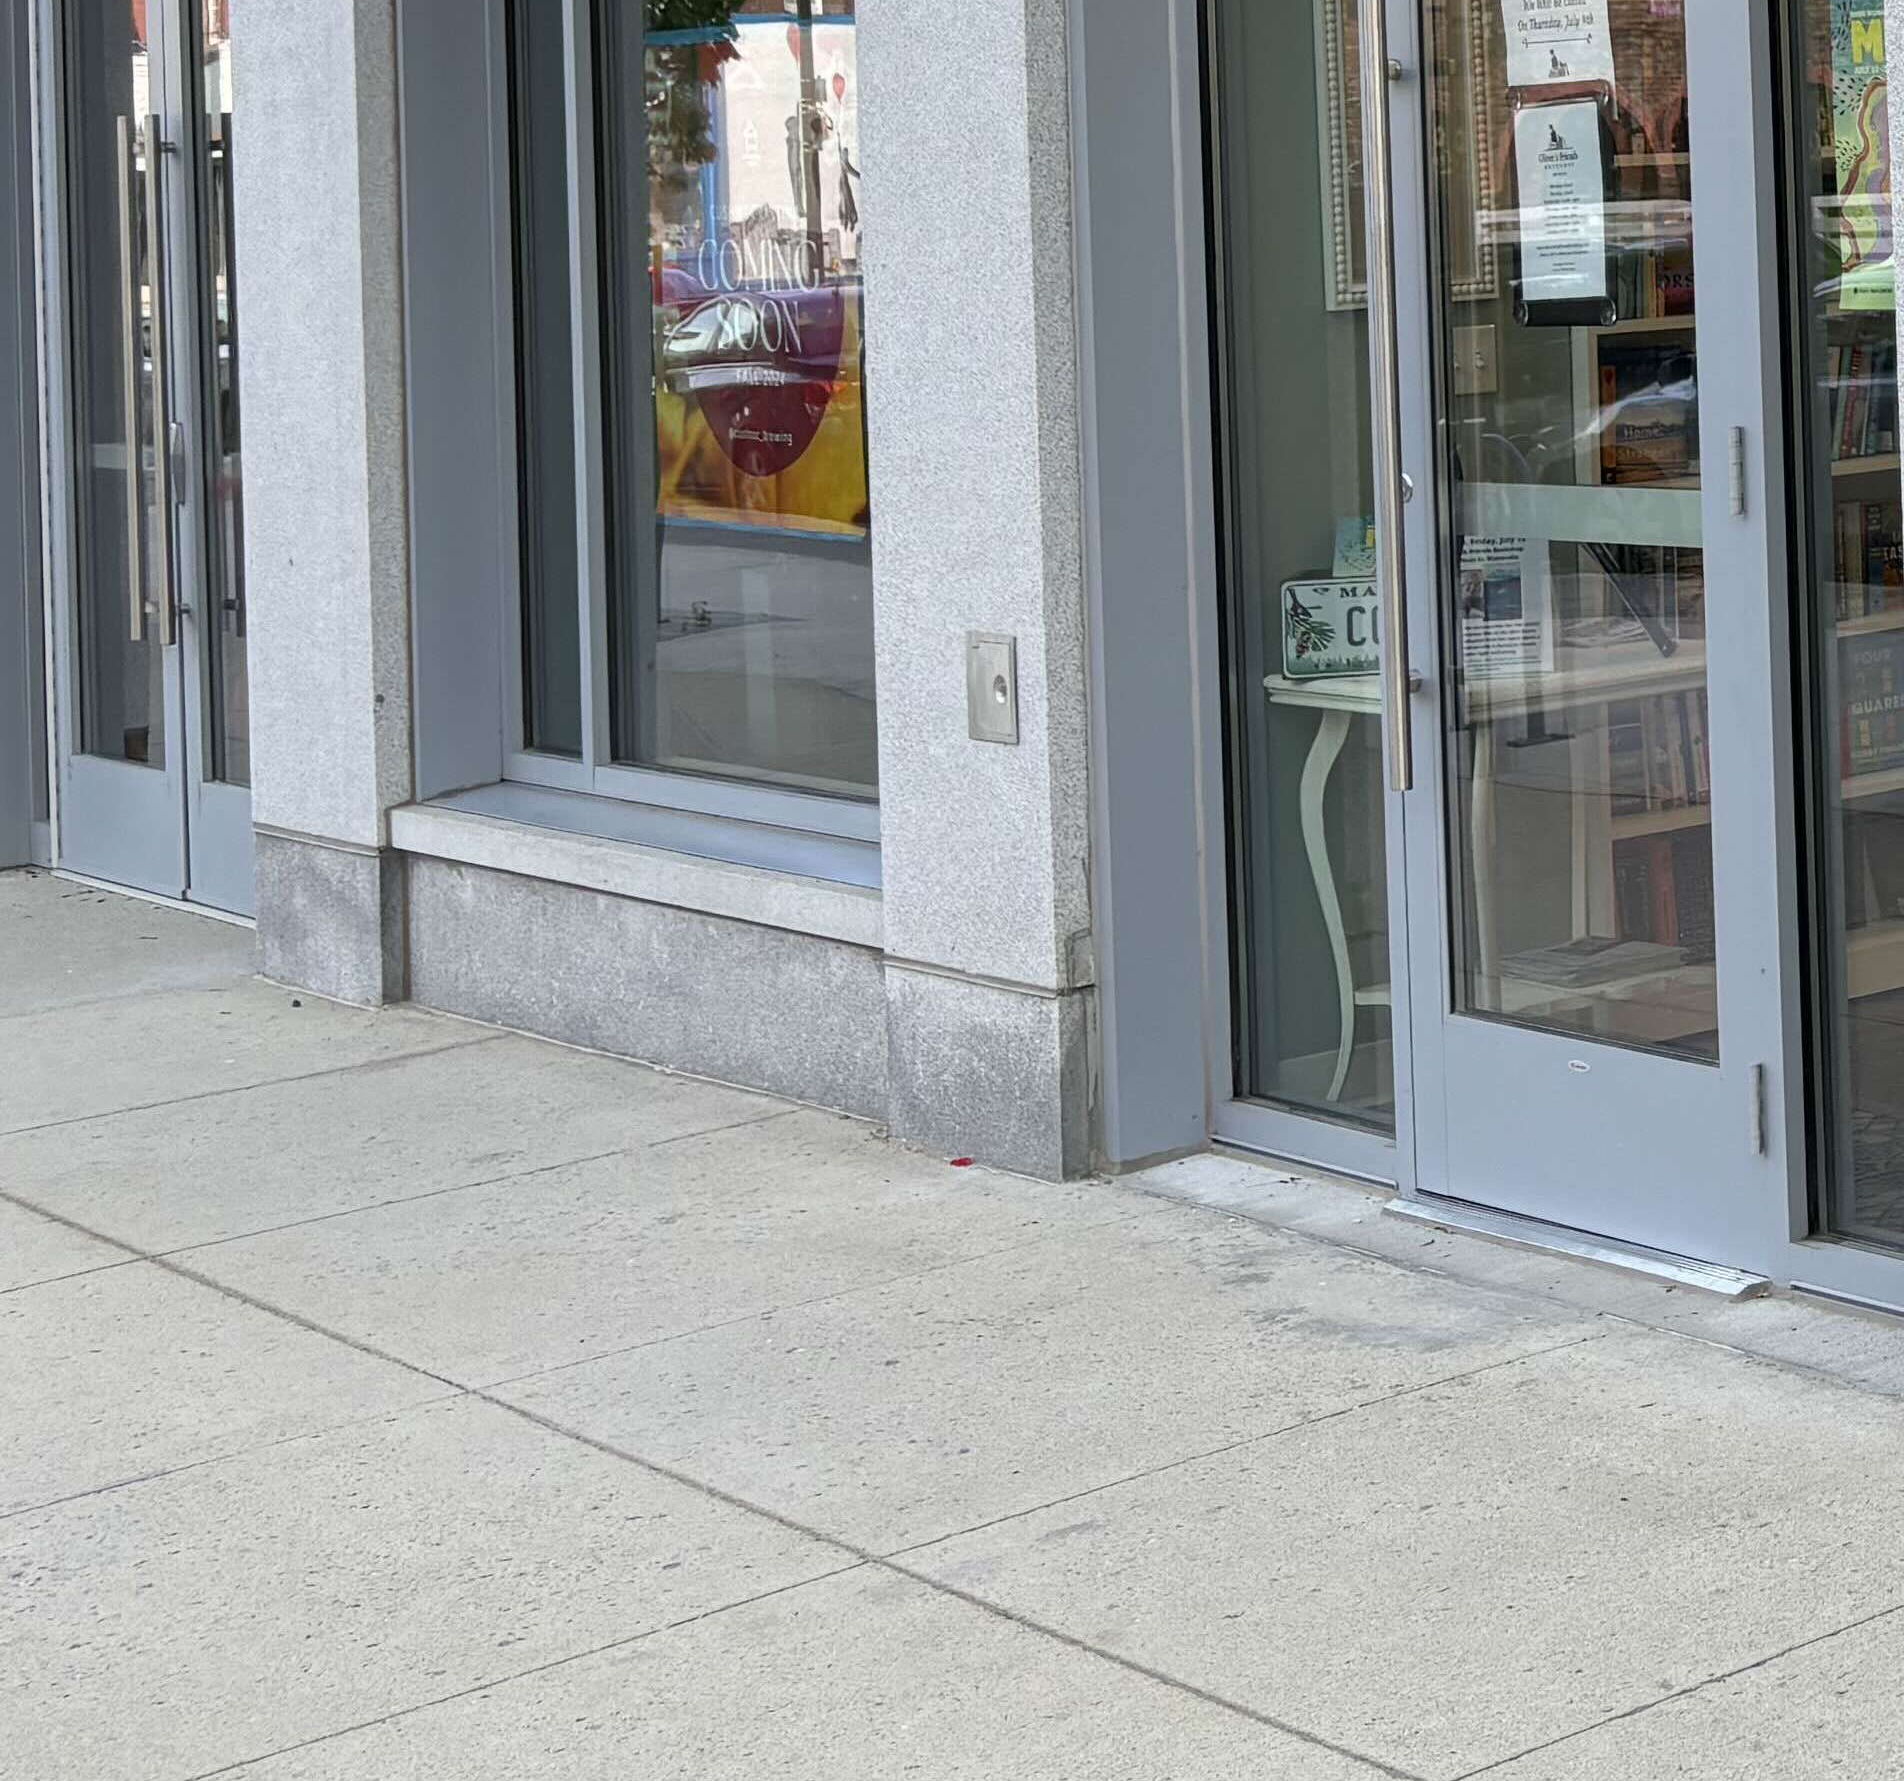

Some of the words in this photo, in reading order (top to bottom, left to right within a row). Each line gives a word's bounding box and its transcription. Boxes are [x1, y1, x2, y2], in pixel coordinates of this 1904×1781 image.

[699, 238, 820, 293] COMING
[716, 297, 803, 353] SOON
[1340, 585, 1377, 598] MA
